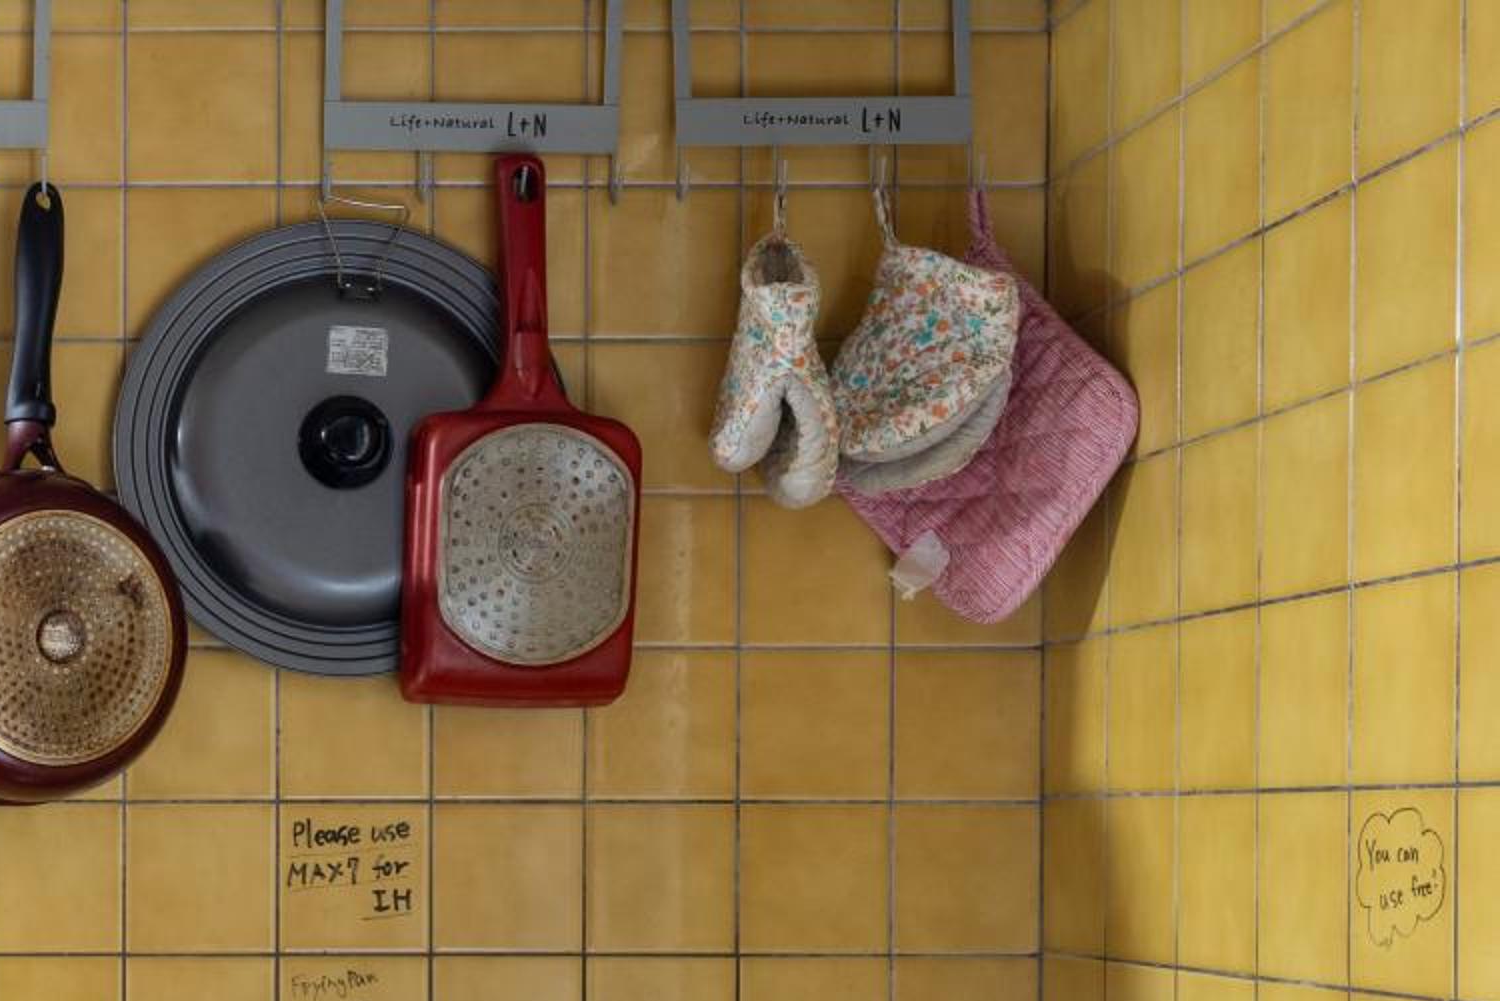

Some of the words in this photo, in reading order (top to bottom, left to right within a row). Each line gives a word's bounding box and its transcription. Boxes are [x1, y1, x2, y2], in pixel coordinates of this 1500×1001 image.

[389, 113, 496, 131] Life+Natural
[507, 111, 548, 137] L+N
[861, 106, 902, 133] L+N
[293, 818, 361, 848] Please
[371, 821, 411, 842] use
[372, 854, 411, 879] for
[1365, 839, 1390, 870] You
[1397, 847, 1419, 863] can
[372, 888, 412, 912] IH
[1380, 889, 1404, 910] use
